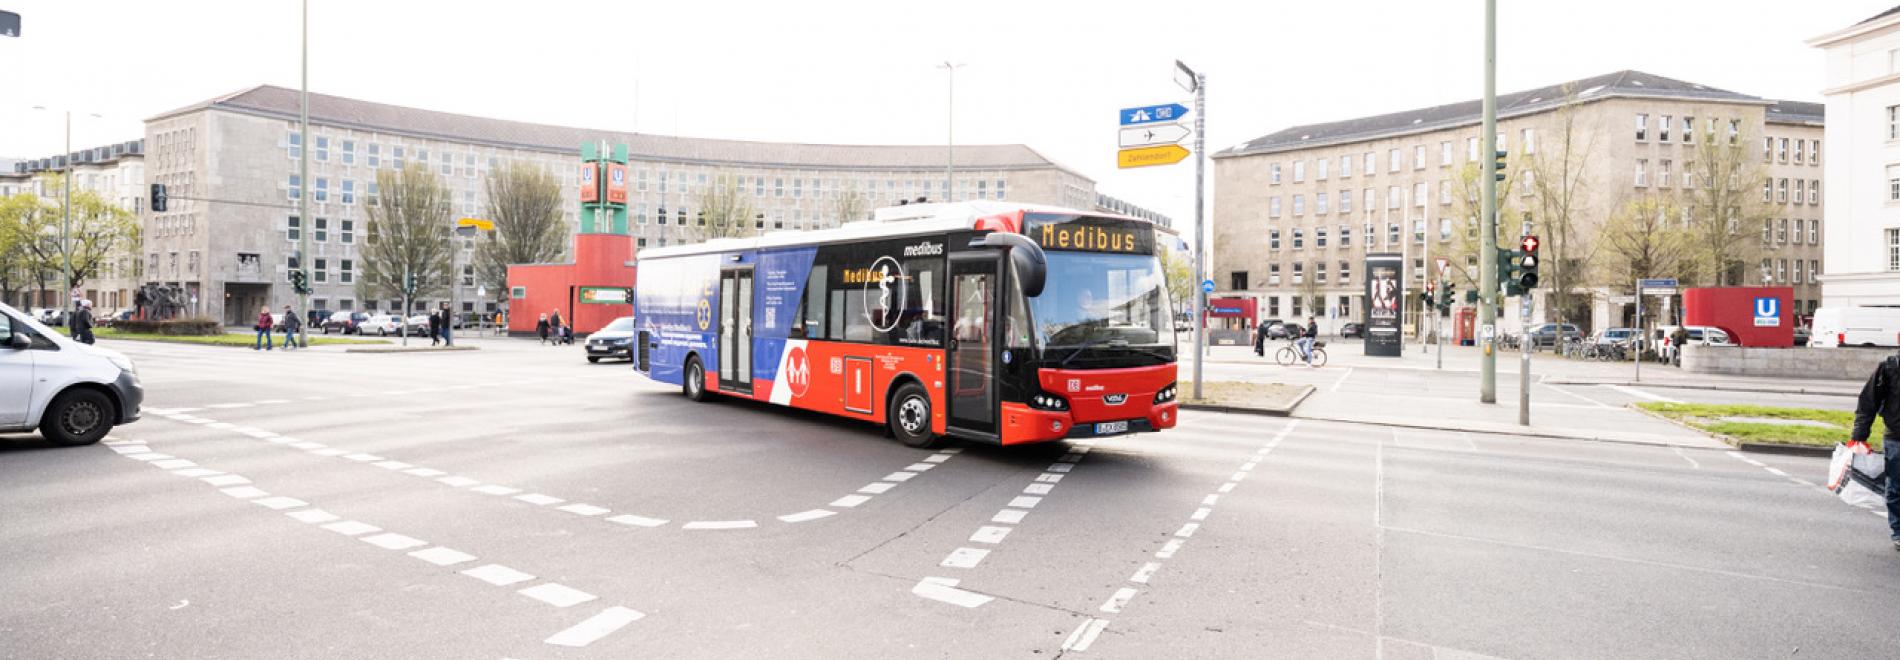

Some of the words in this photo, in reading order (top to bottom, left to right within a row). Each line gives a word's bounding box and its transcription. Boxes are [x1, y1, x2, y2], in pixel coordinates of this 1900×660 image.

[1042, 223, 1135, 251] Medibus
[904, 241, 943, 256] medibus
[1758, 299, 1776, 317] U
